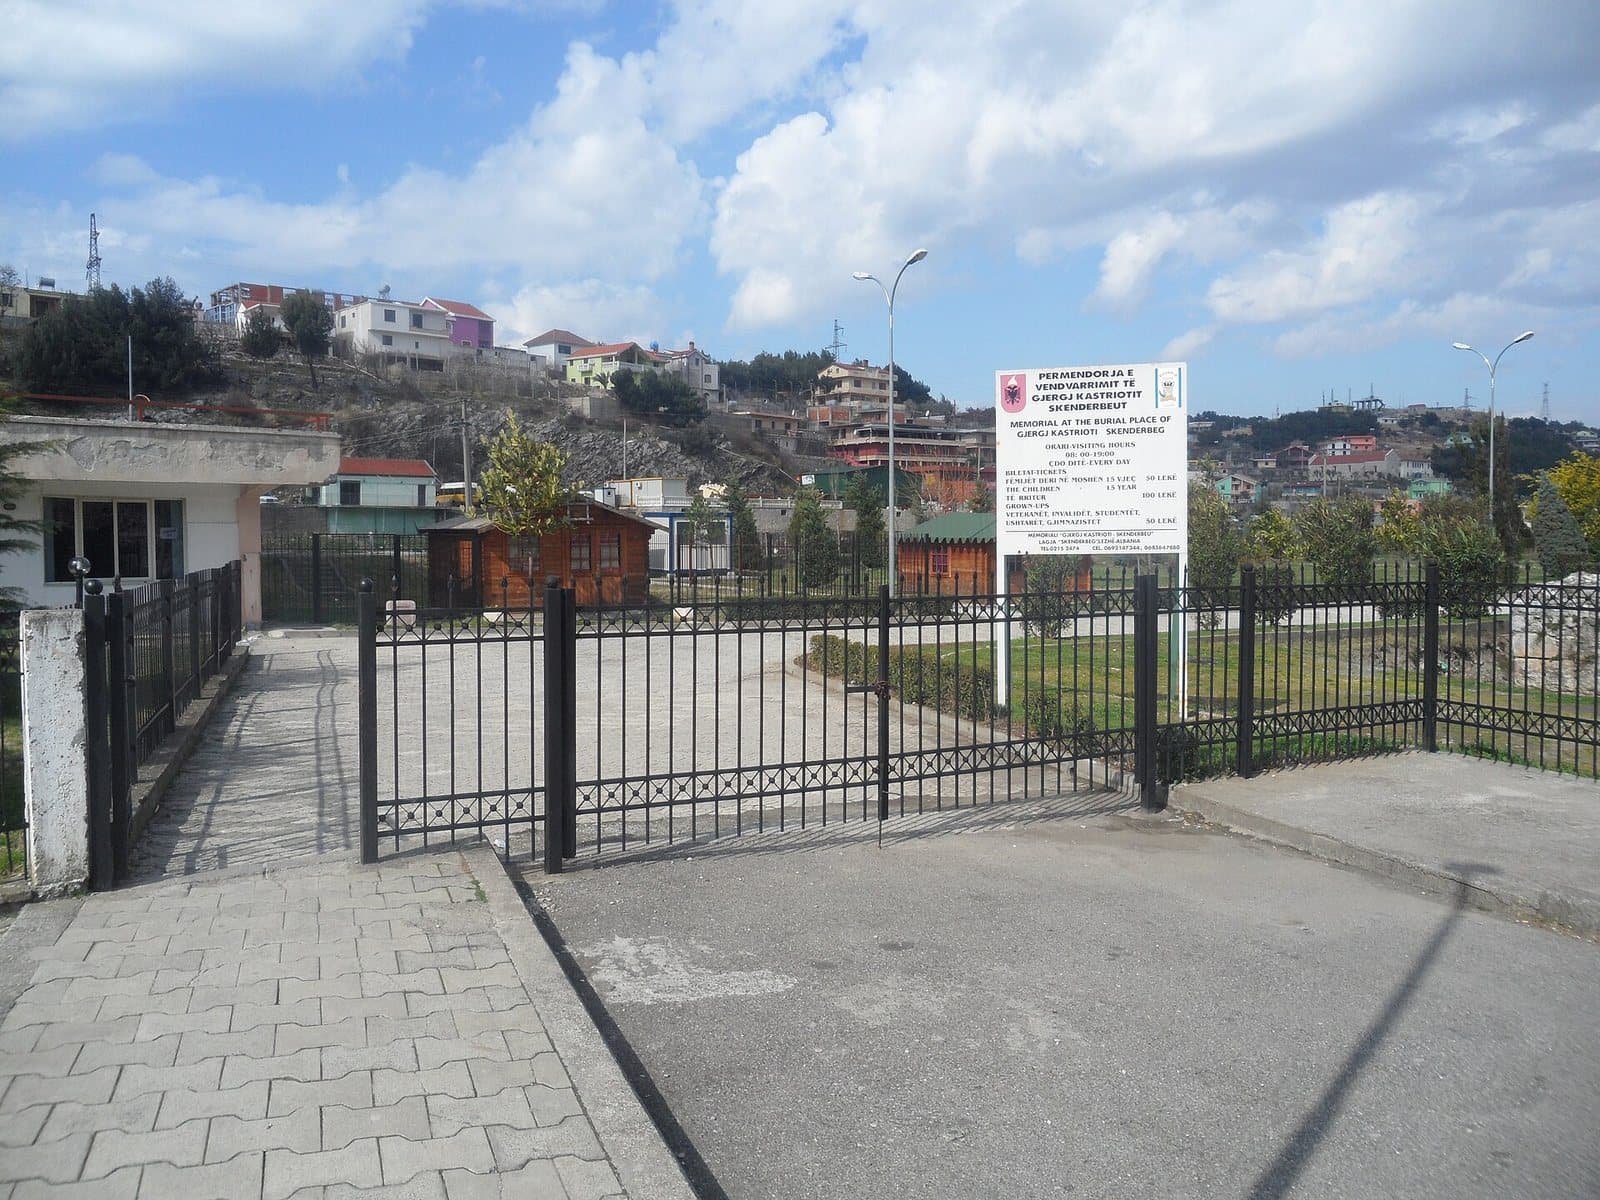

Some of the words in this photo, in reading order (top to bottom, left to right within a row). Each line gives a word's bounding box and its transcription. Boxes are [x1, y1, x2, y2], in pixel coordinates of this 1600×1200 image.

[1039, 370, 1125, 380] PERMENDORJA
[1128, 369, 1134, 377] E
[1035, 381, 1119, 391] VENDVARRIMIT
[1123, 378, 1136, 387] TË
[1032, 393, 1074, 402] GJERGJ
[1076, 391, 1143, 400] KASTRIOTIT
[1048, 402, 1128, 412] SKENDERBEUT
[1010, 419, 1058, 428] MEMORIAL
[1075, 418, 1092, 426] THE
[1094, 417, 1127, 425] BURIAL
[1129, 416, 1157, 424] PLACE
[1160, 415, 1172, 423] OF
[1017, 430, 1049, 438] GJERGJ
[1051, 428, 1098, 437] KASTRIOTI
[1106, 427, 1165, 436] SKENDERBEG
[1108, 441, 1136, 449] HOURS
